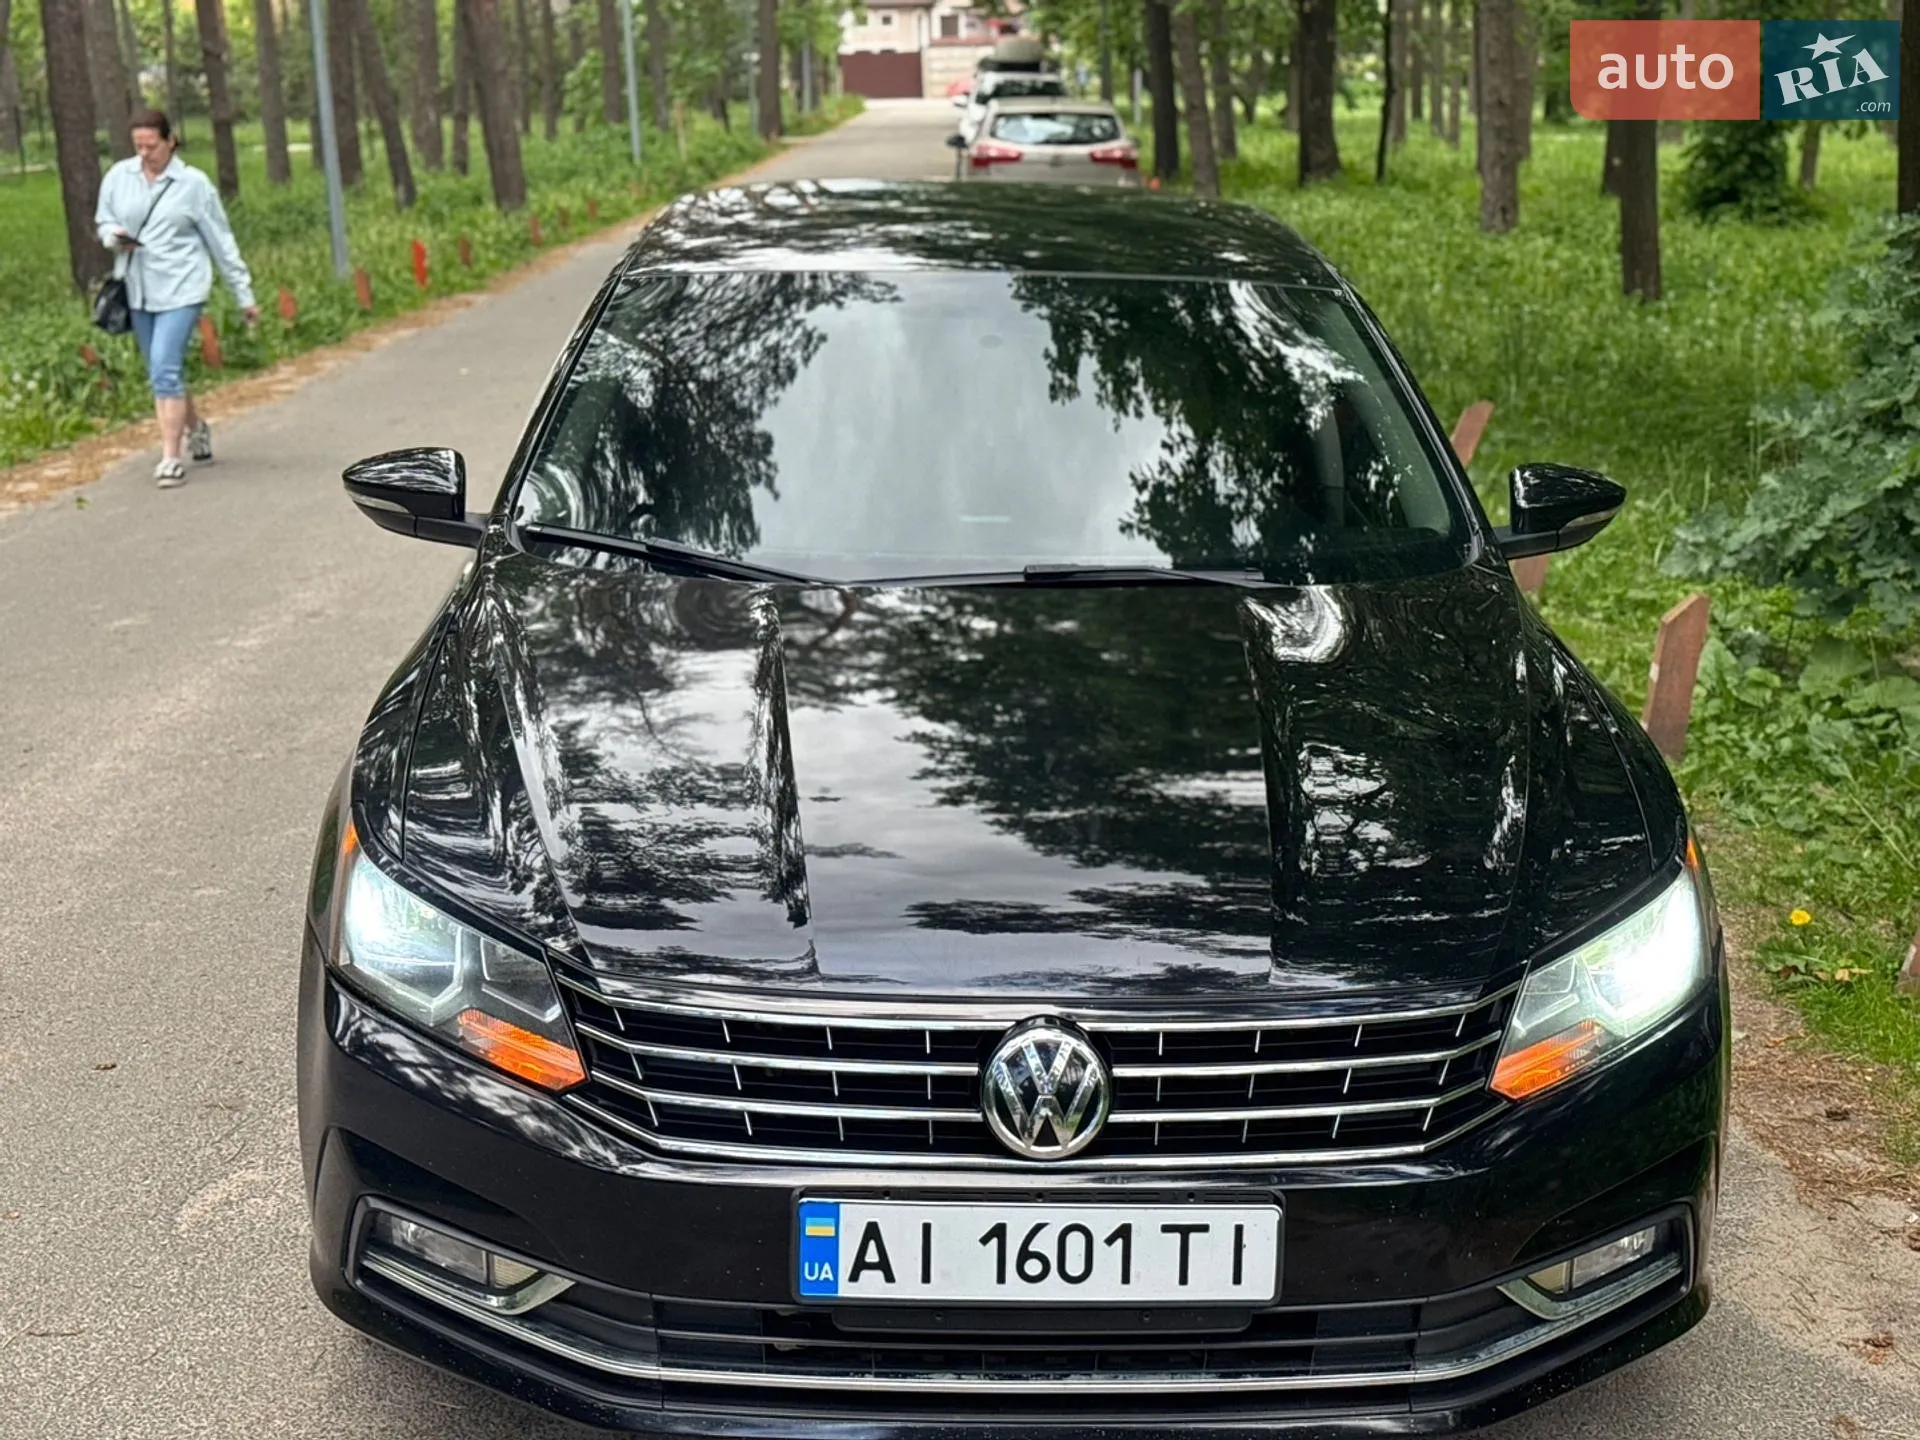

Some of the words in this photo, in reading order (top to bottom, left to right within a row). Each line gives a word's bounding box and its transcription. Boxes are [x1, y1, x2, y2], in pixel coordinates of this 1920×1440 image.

[804, 1262, 835, 1282] UA
[847, 1220, 932, 1285] AI
[977, 1221, 1132, 1286] 1601
[1160, 1223, 1244, 1287] TI
